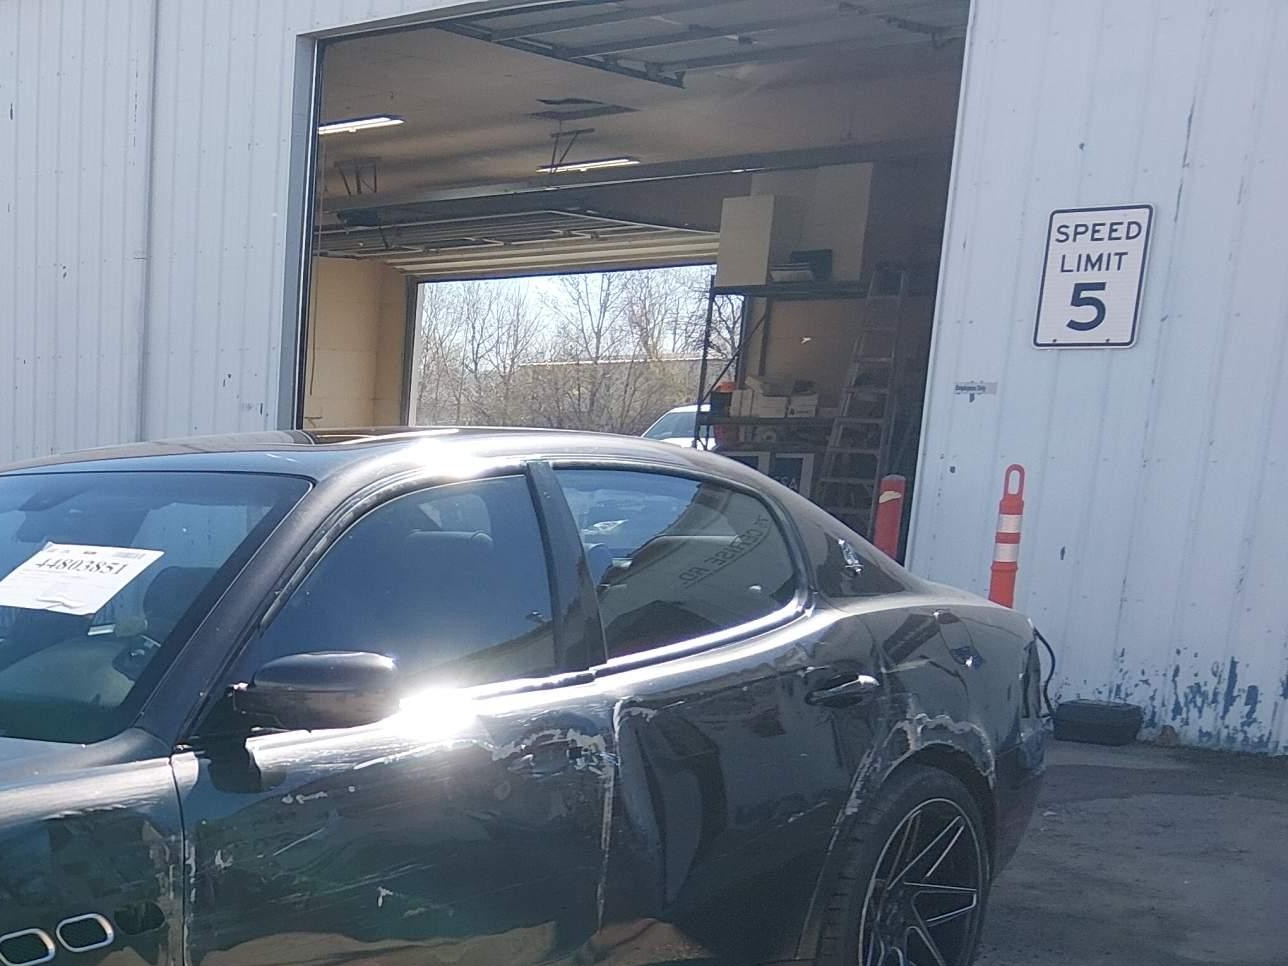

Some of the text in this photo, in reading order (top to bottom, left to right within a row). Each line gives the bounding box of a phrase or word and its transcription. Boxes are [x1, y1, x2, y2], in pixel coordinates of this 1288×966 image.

[1055, 221, 1142, 243] SPEED
[1060, 252, 1129, 273] LIMIT
[1066, 282, 1107, 332] 5
[35, 558, 128, 575] 44803851
